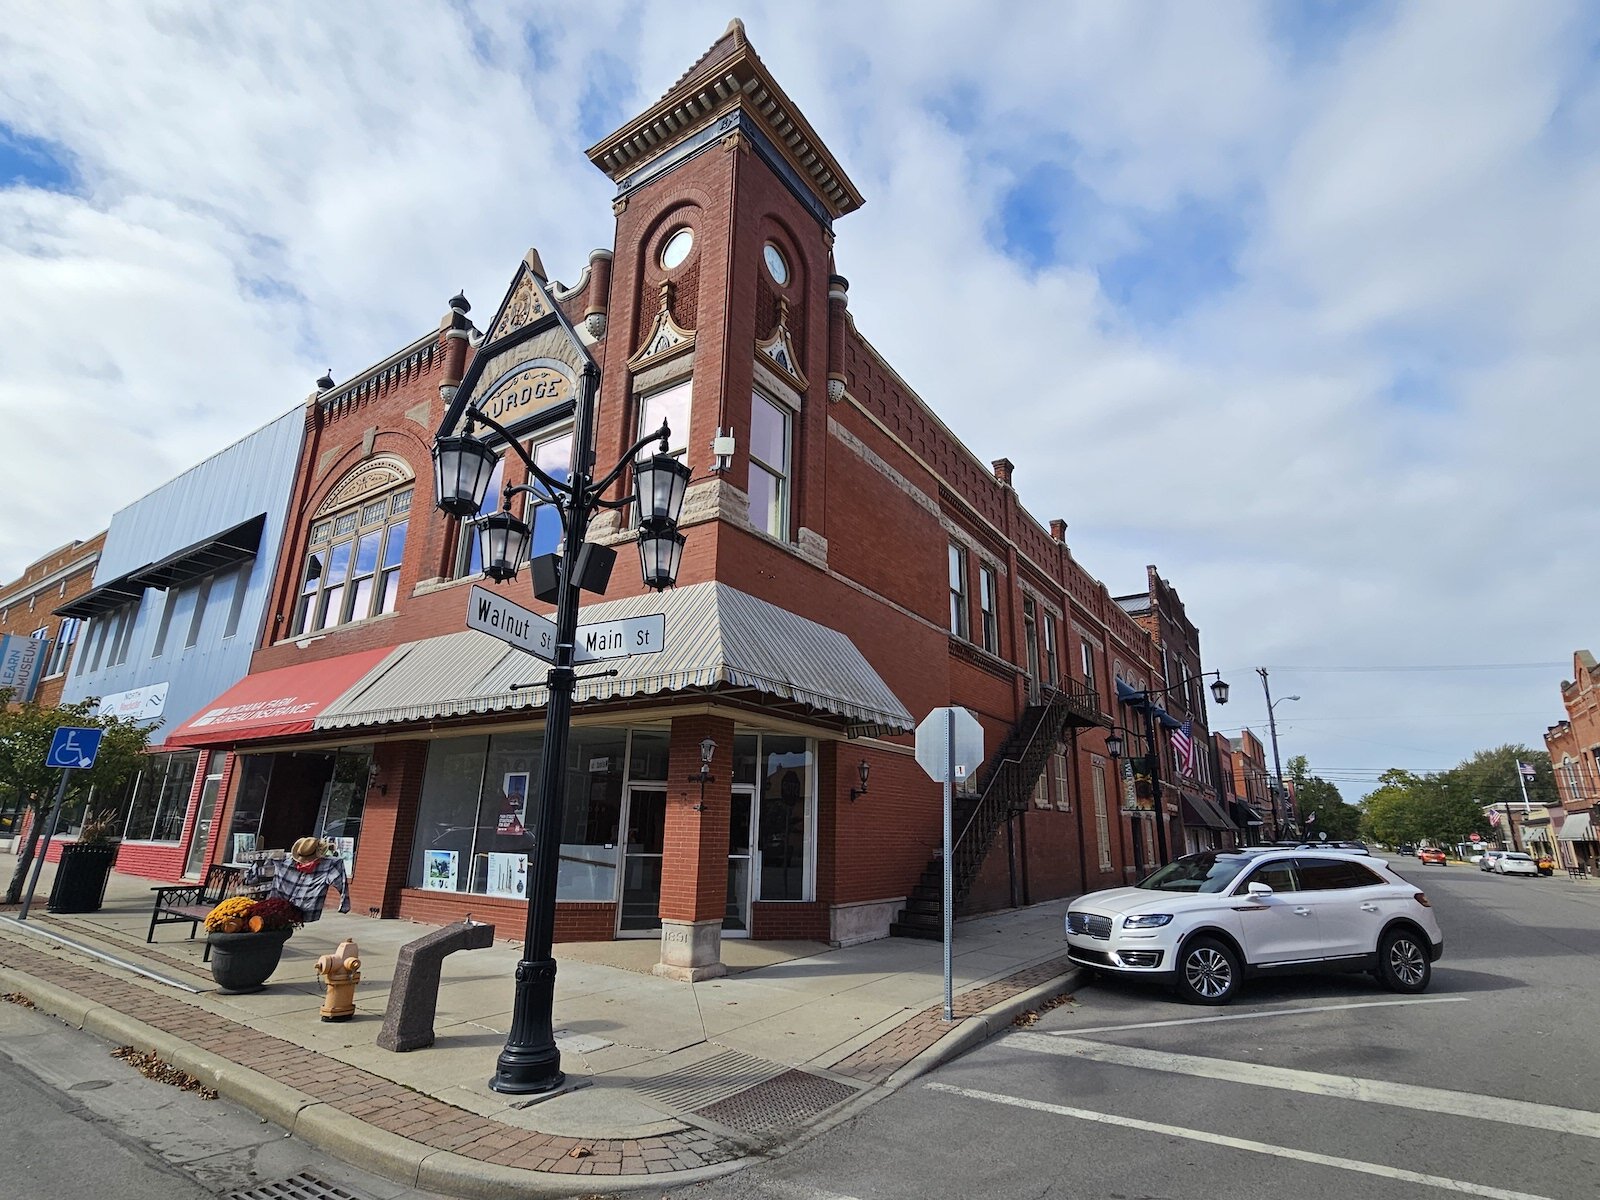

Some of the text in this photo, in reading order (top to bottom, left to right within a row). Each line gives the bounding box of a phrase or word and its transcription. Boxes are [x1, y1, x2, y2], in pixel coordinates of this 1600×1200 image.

[479, 597, 551, 650] Walnut St
[586, 629, 650, 652] Main St
[2, 650, 21, 685] LEARN
[16, 640, 39, 687] MUSEUM
[664, 931, 688, 943] 1891
